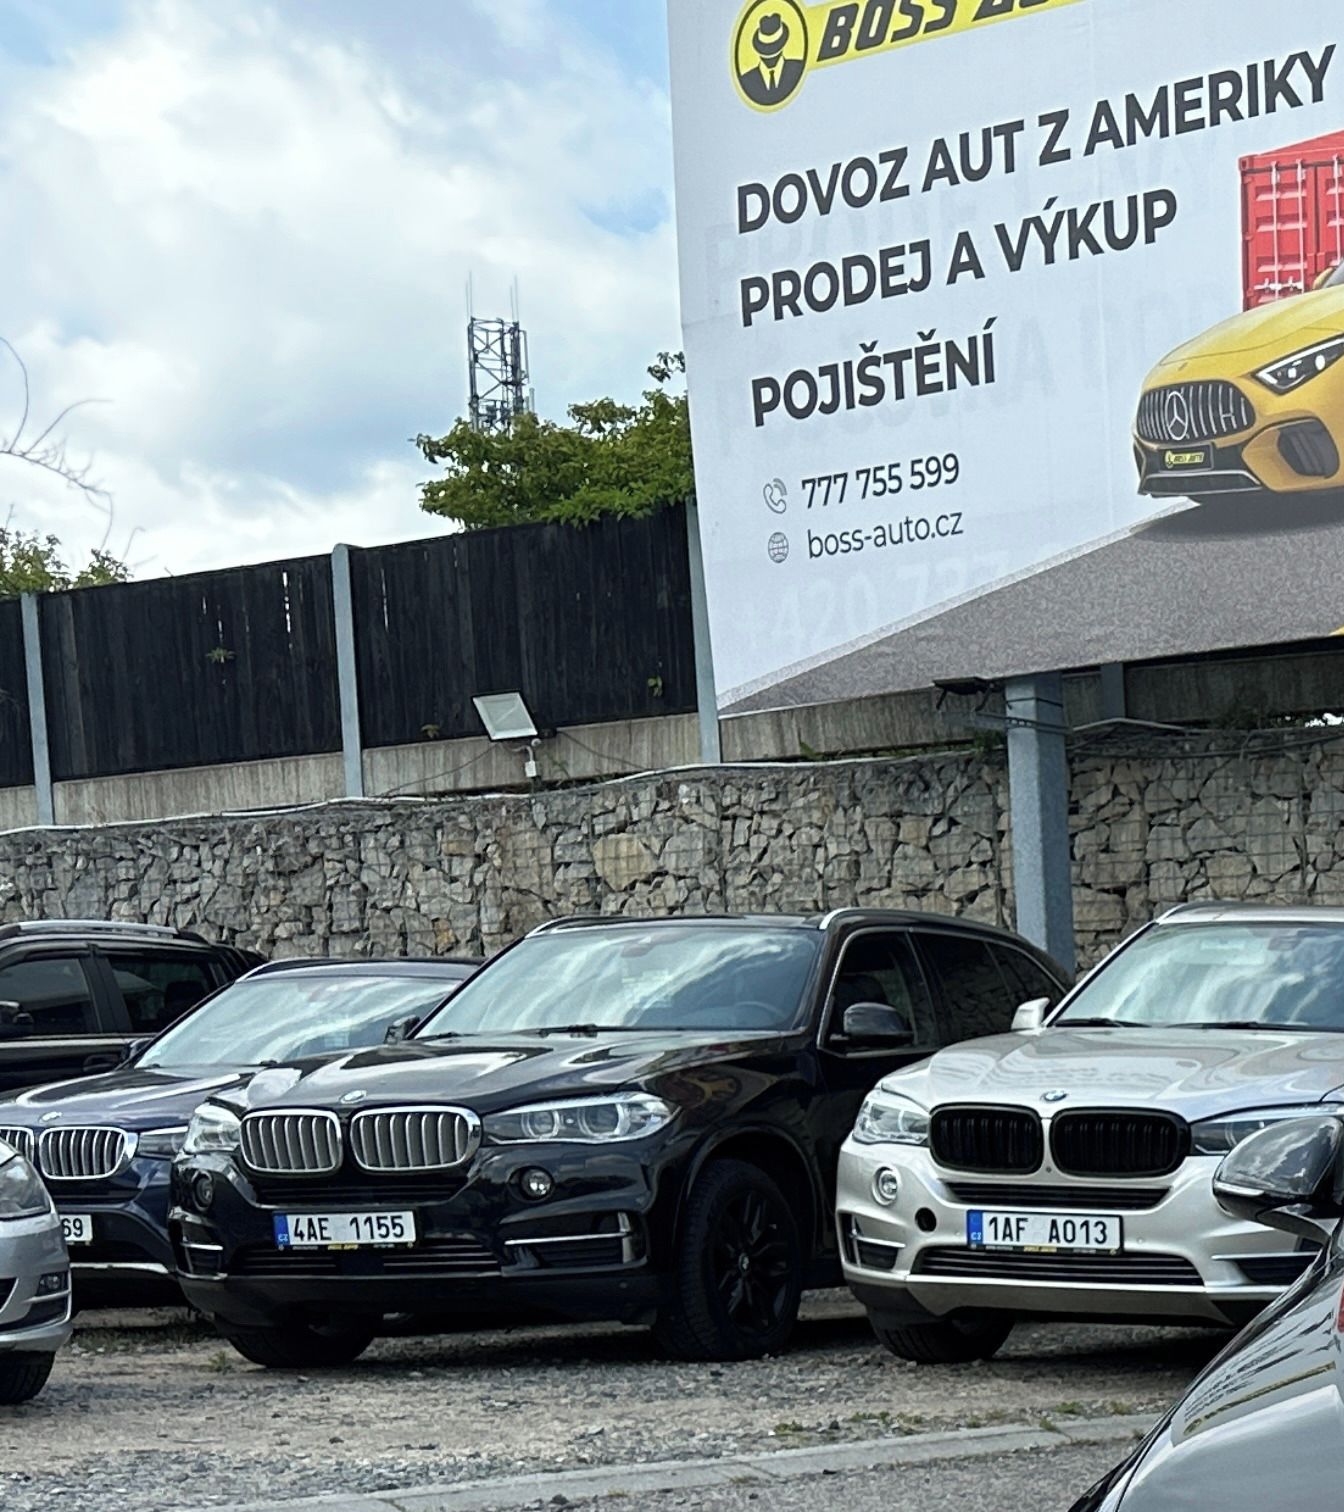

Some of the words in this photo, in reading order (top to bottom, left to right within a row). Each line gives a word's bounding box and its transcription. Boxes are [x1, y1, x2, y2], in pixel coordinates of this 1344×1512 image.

[816, 0, 959, 62] BOSS
[737, 147, 911, 235] DOVOZ
[921, 118, 1025, 193] AUT
[1037, 107, 1072, 167] Z
[1083, 43, 1338, 157] AMERIKY
[740, 238, 932, 328] PRODEJ
[946, 230, 986, 285] A
[994, 188, 1178, 273] VÝKUP
[751, 316, 998, 428] POJIŠTĚNÍ
[801, 472, 848, 509] 777
[855, 462, 902, 500] 755
[909, 452, 960, 491] 599
[807, 511, 964, 559] boss-auto.cz
[293, 1217, 332, 1242] 4AE
[349, 1214, 405, 1240] 1155
[988, 1216, 1029, 1242] 1AF
